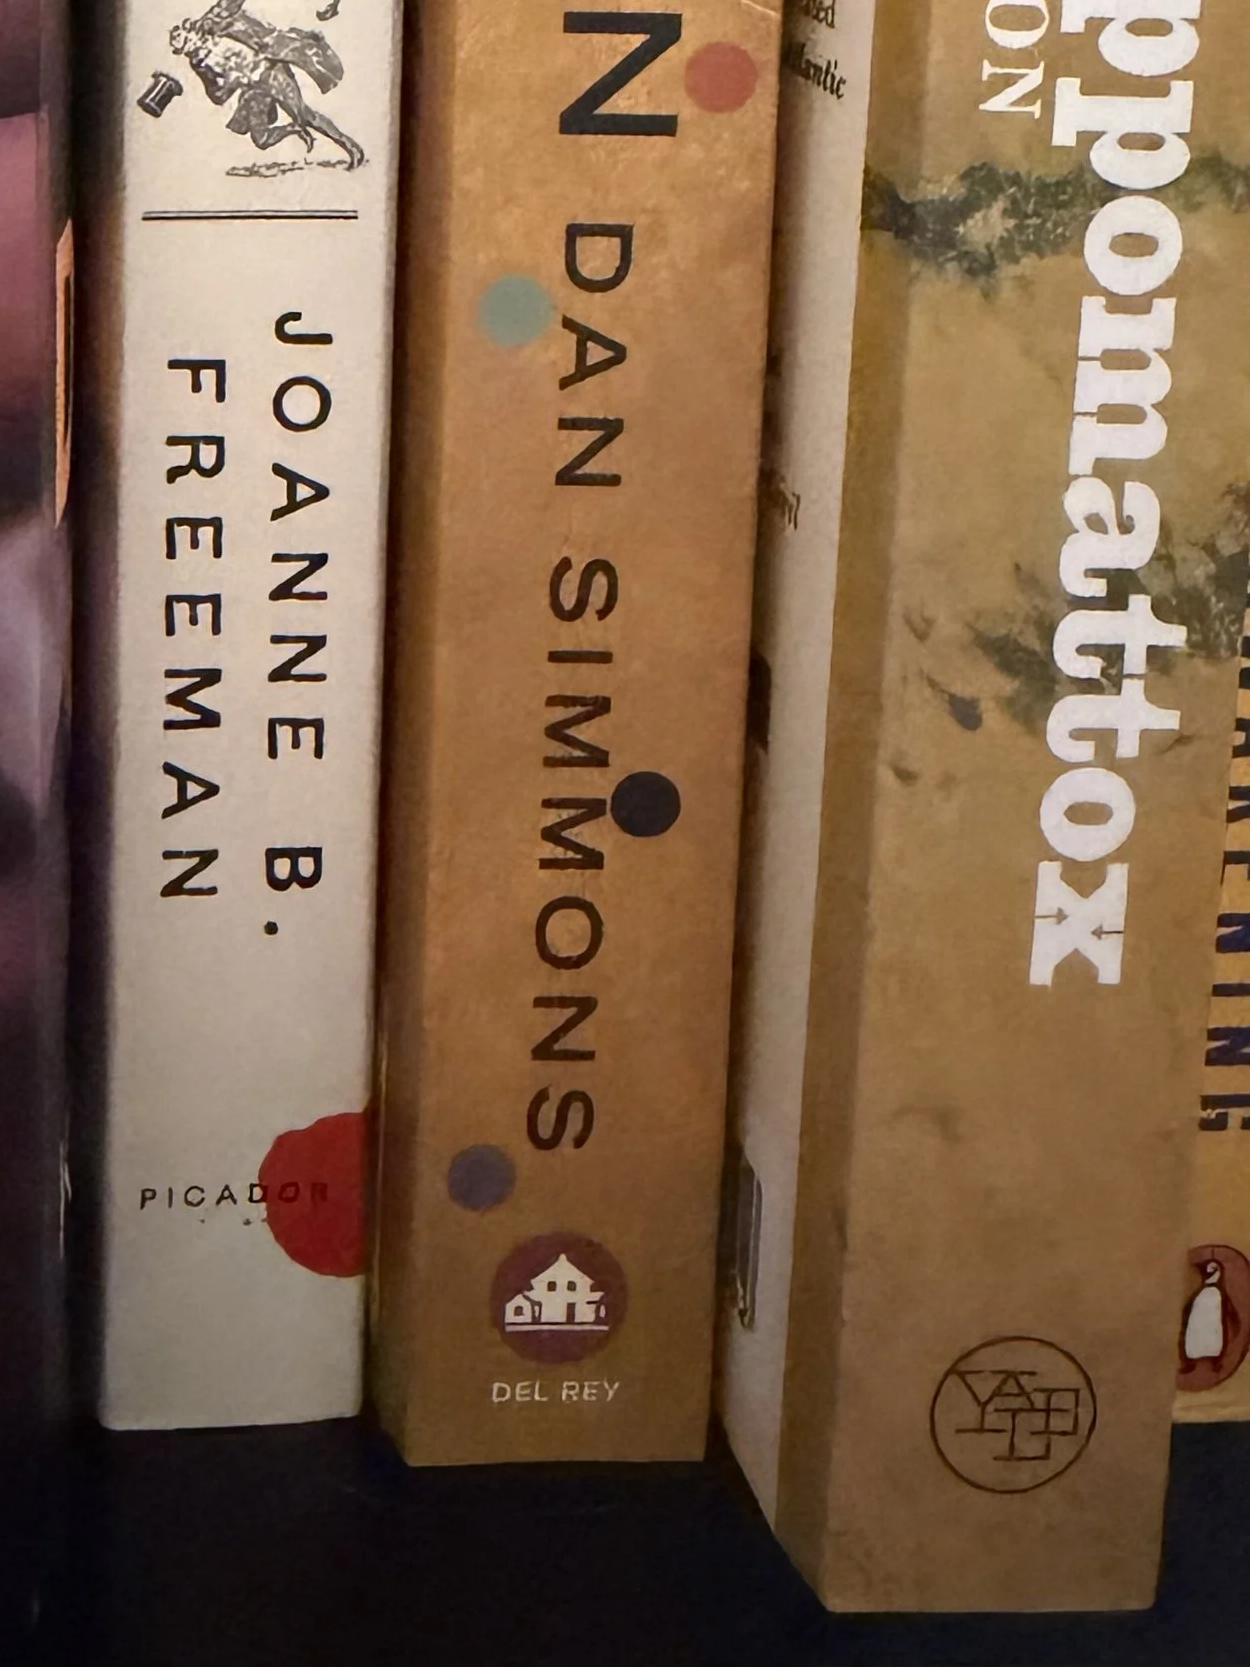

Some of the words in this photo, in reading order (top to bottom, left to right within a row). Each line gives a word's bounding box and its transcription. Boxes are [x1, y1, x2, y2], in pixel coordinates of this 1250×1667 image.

[556, 223, 634, 488] DAN
[161, 358, 227, 898] FREEMAN
[267, 312, 333, 760] JOANNE
[264, 846, 322, 936] B.
[527, 556, 619, 1151] SIMMONS
[139, 1182, 328, 1211] PICADOR
[492, 1381, 549, 1404] DEL
[562, 1381, 620, 1403] REY
